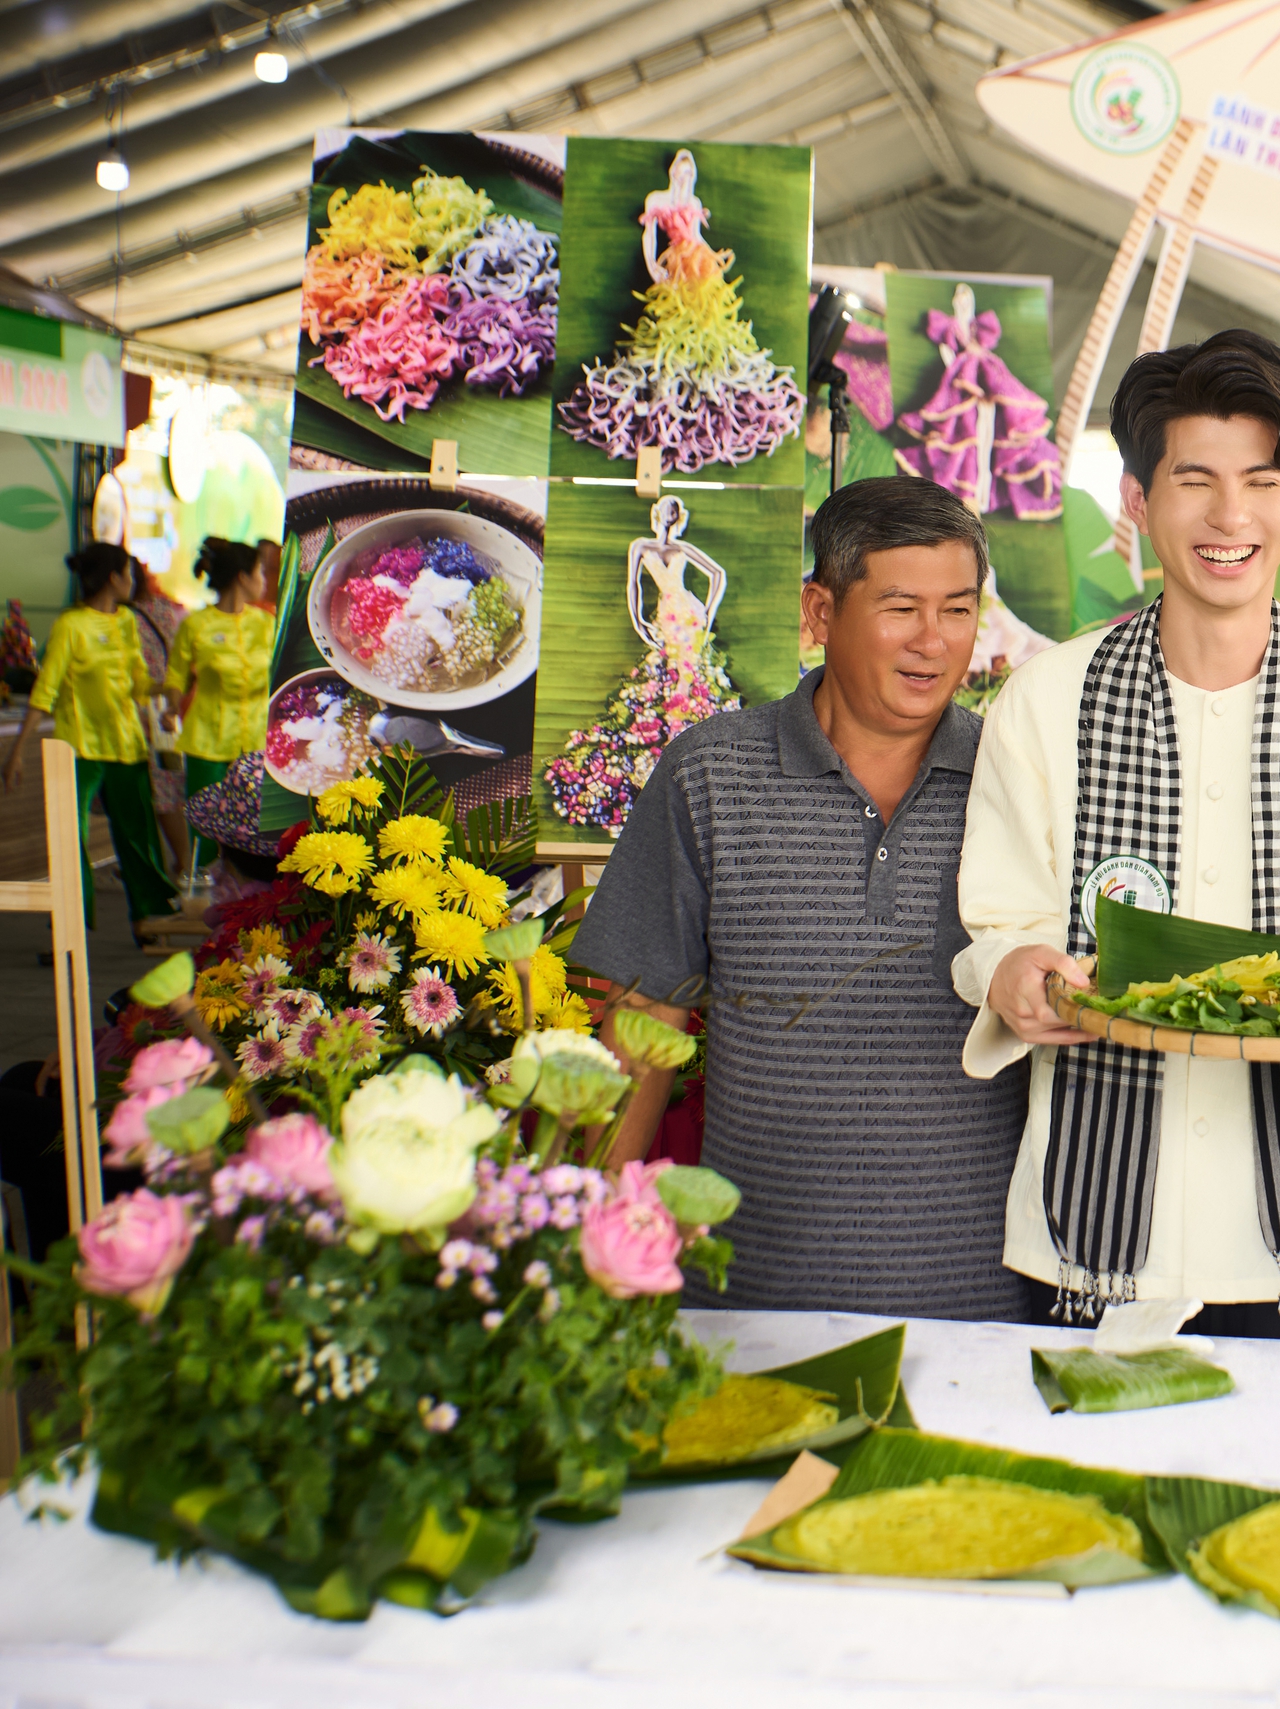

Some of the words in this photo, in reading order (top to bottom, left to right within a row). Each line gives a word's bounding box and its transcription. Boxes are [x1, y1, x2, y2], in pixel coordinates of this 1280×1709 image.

[19, 361, 69, 416] 2024
[1134, 863, 1148, 875] GIAN
[1147, 873, 1160, 889] NAM
